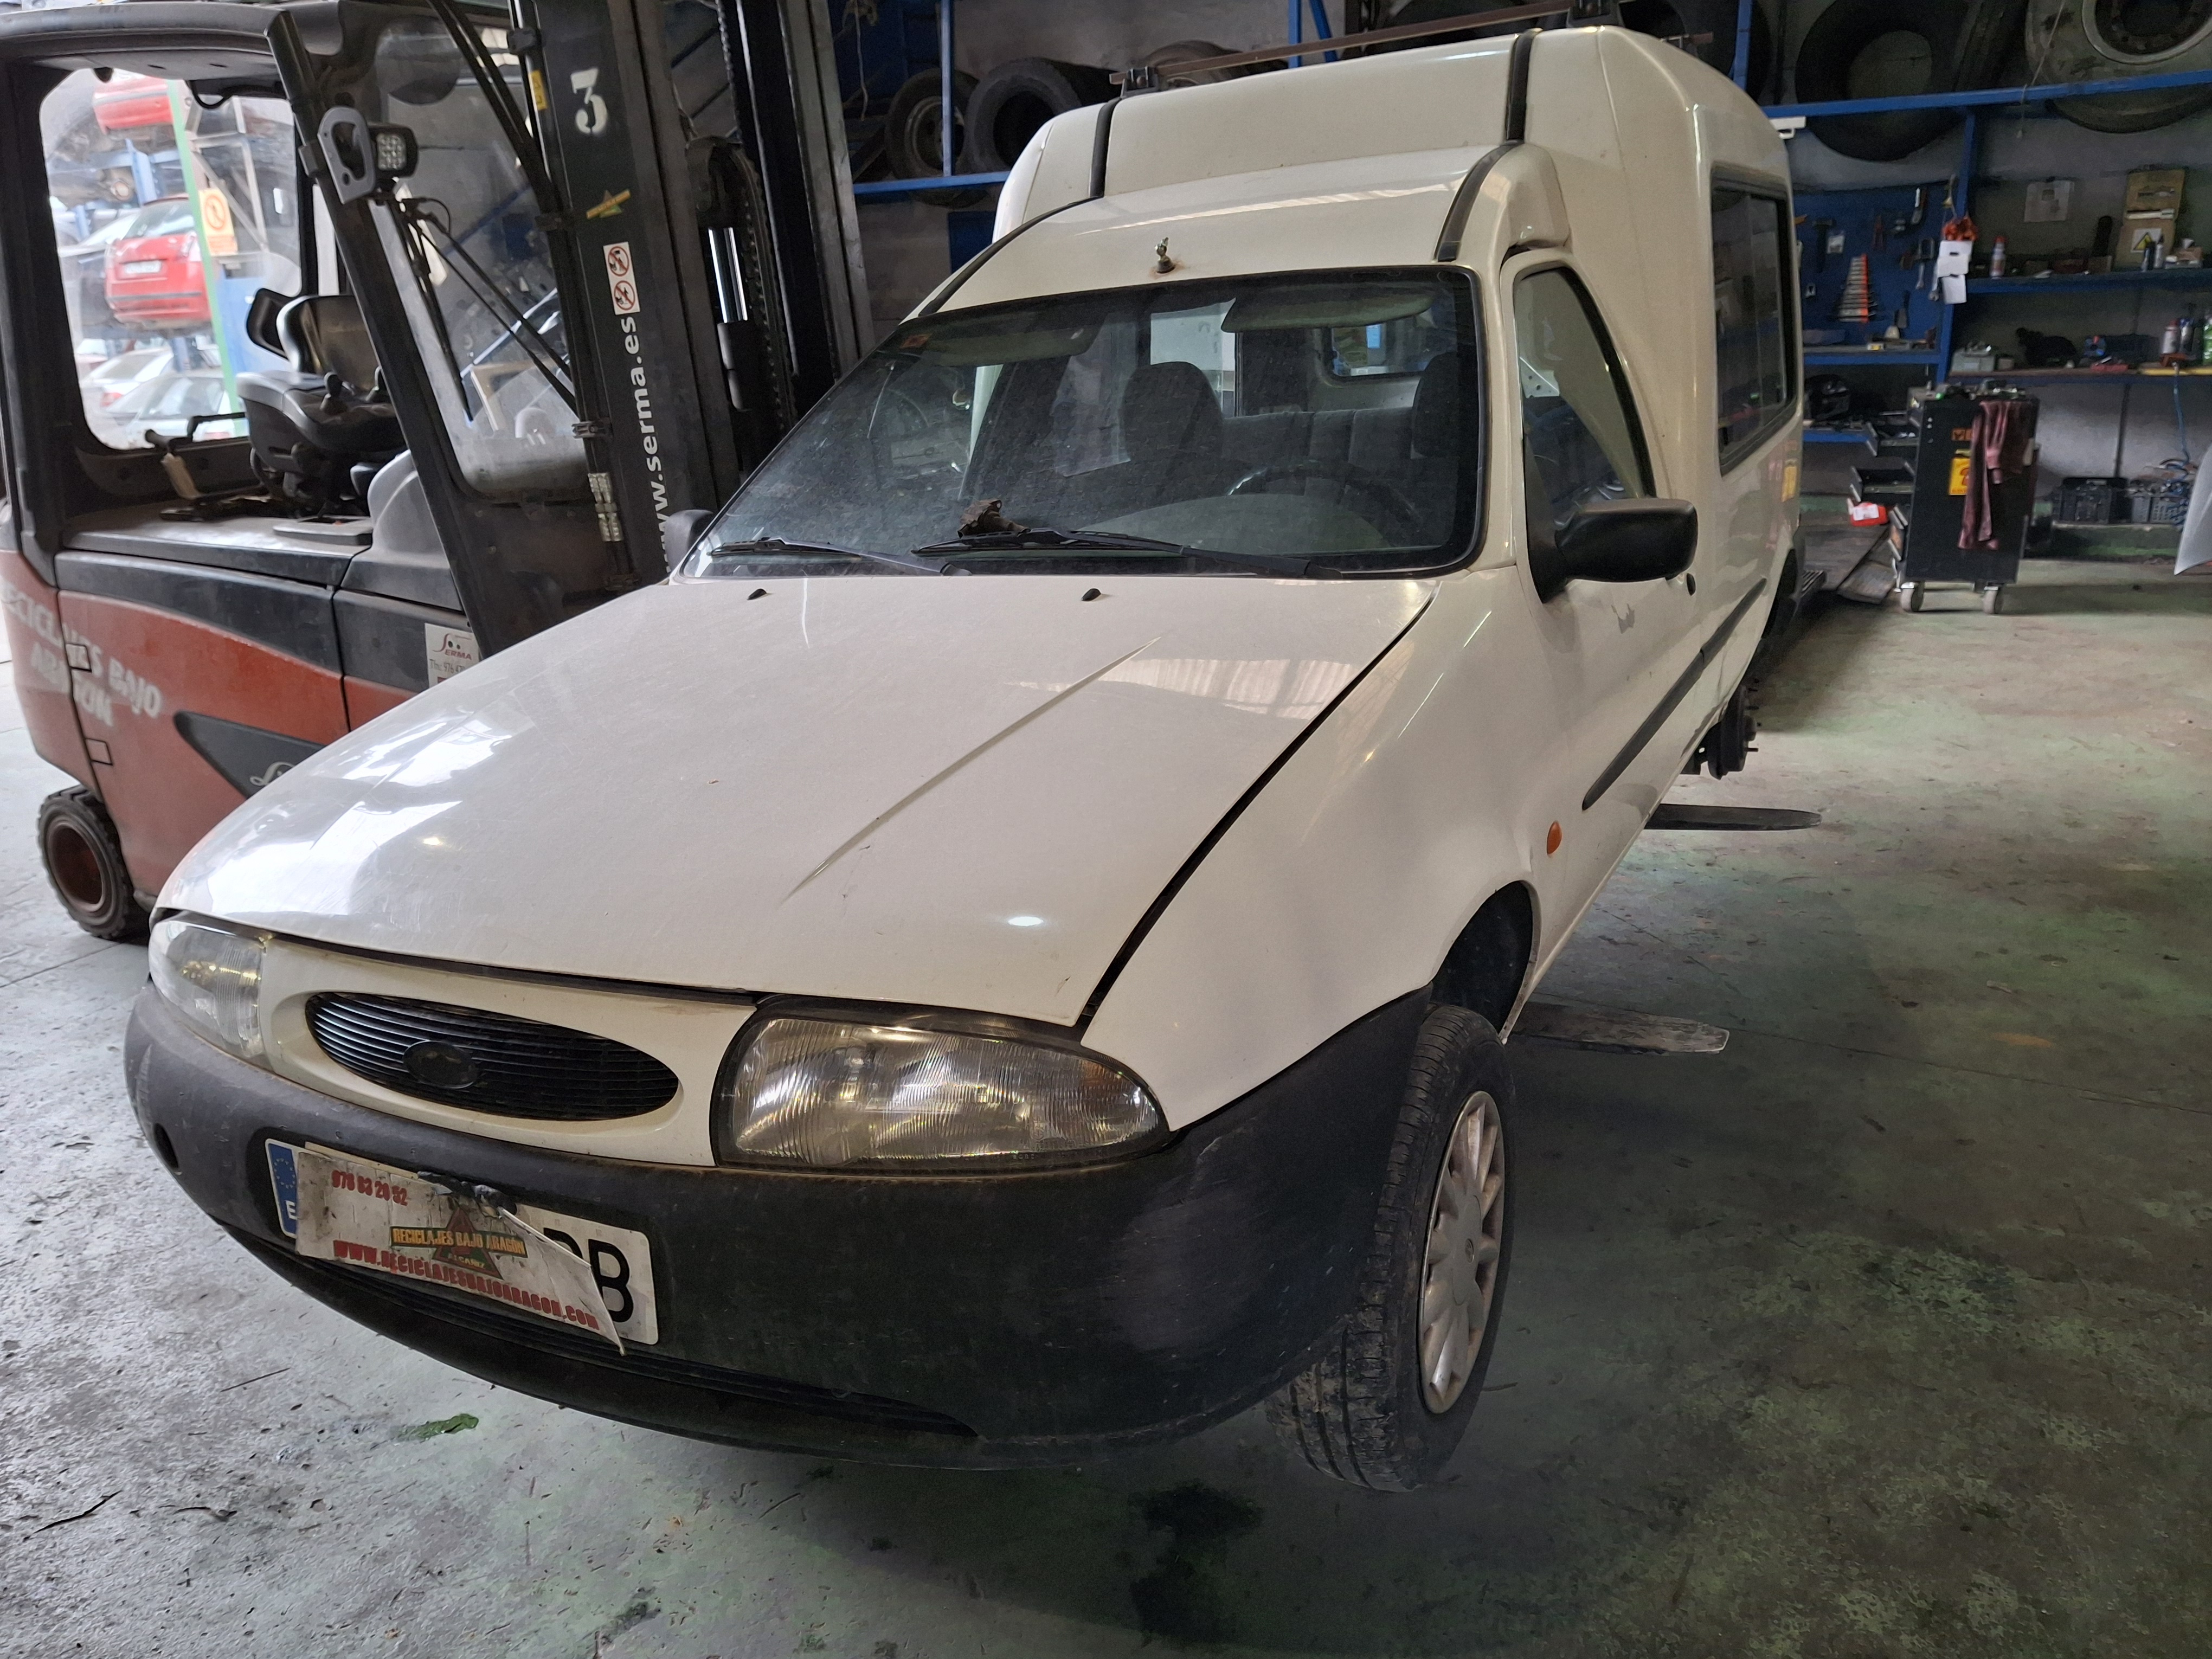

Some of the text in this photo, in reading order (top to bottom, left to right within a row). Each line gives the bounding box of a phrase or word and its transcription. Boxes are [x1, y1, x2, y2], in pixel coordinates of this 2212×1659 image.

[570, 67, 607, 133] 3
[621, 317, 672, 573] ww.serma.es
[374, 1180, 390, 1201] 20
[391, 1185, 408, 1206] 52
[285, 1200, 297, 1220] E
[393, 1227, 454, 1246] RECICLAJES
[456, 1231, 483, 1248] BAJO
